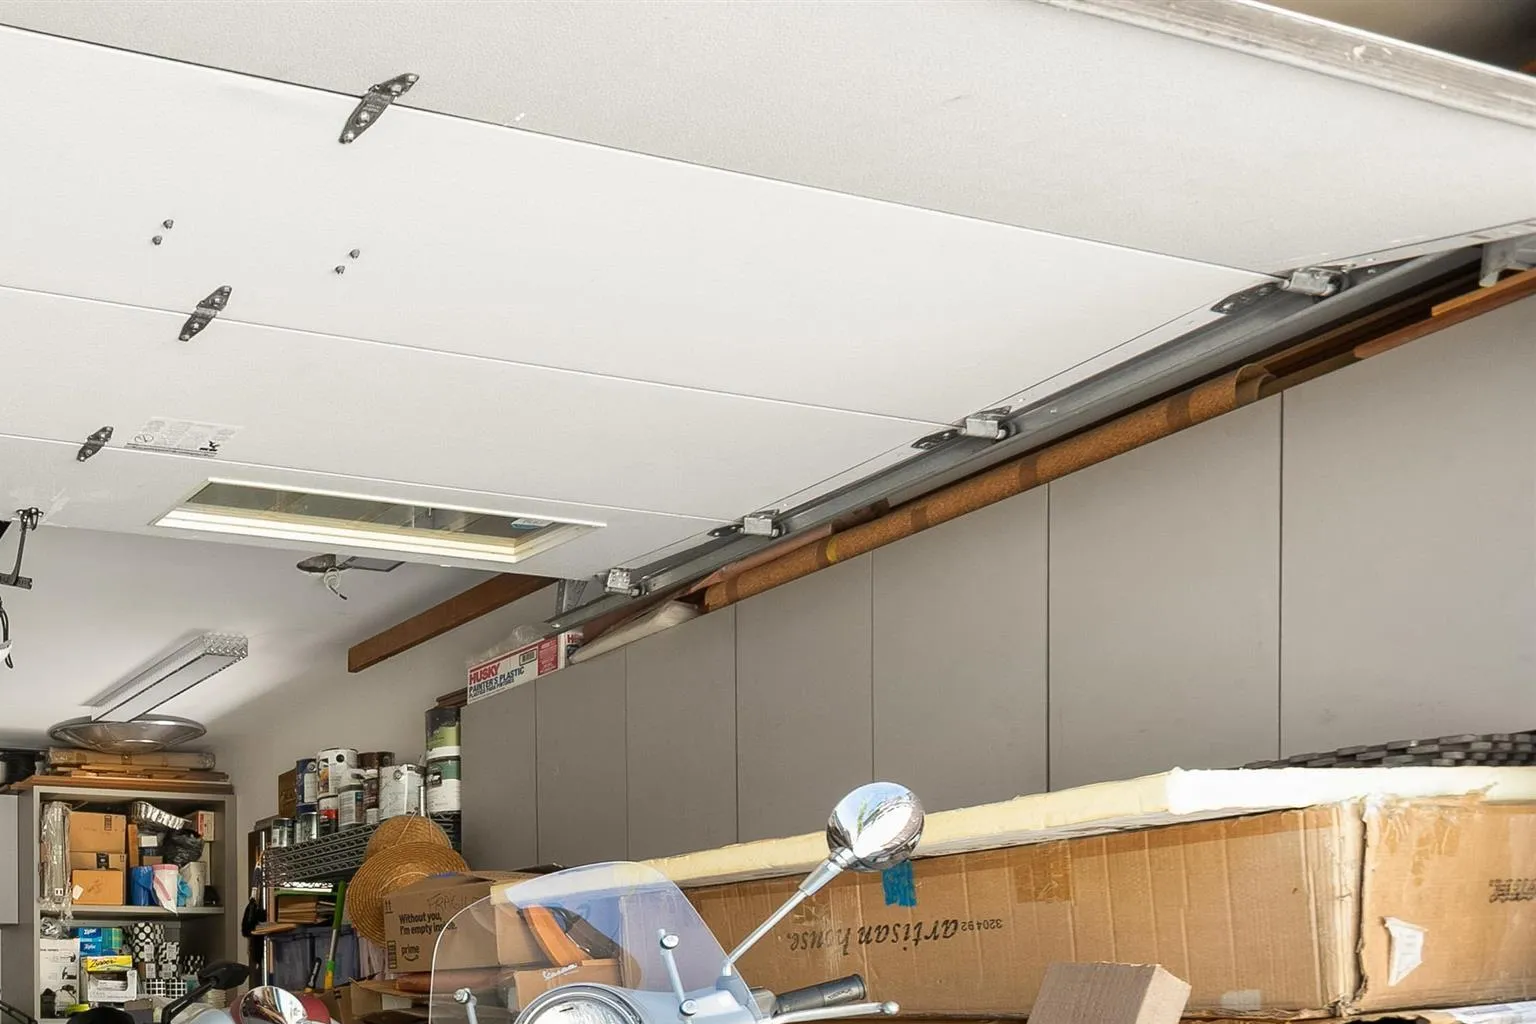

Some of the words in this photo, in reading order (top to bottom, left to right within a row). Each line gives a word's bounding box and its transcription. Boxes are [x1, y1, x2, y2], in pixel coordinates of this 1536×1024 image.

[469, 662, 501, 685] HUSKY
[498, 666, 525, 682] PLASTIC
[399, 911, 426, 924] Without
[427, 911, 442, 923] you,
[411, 924, 432, 935] empty
[857, 918, 959, 951] artisan
